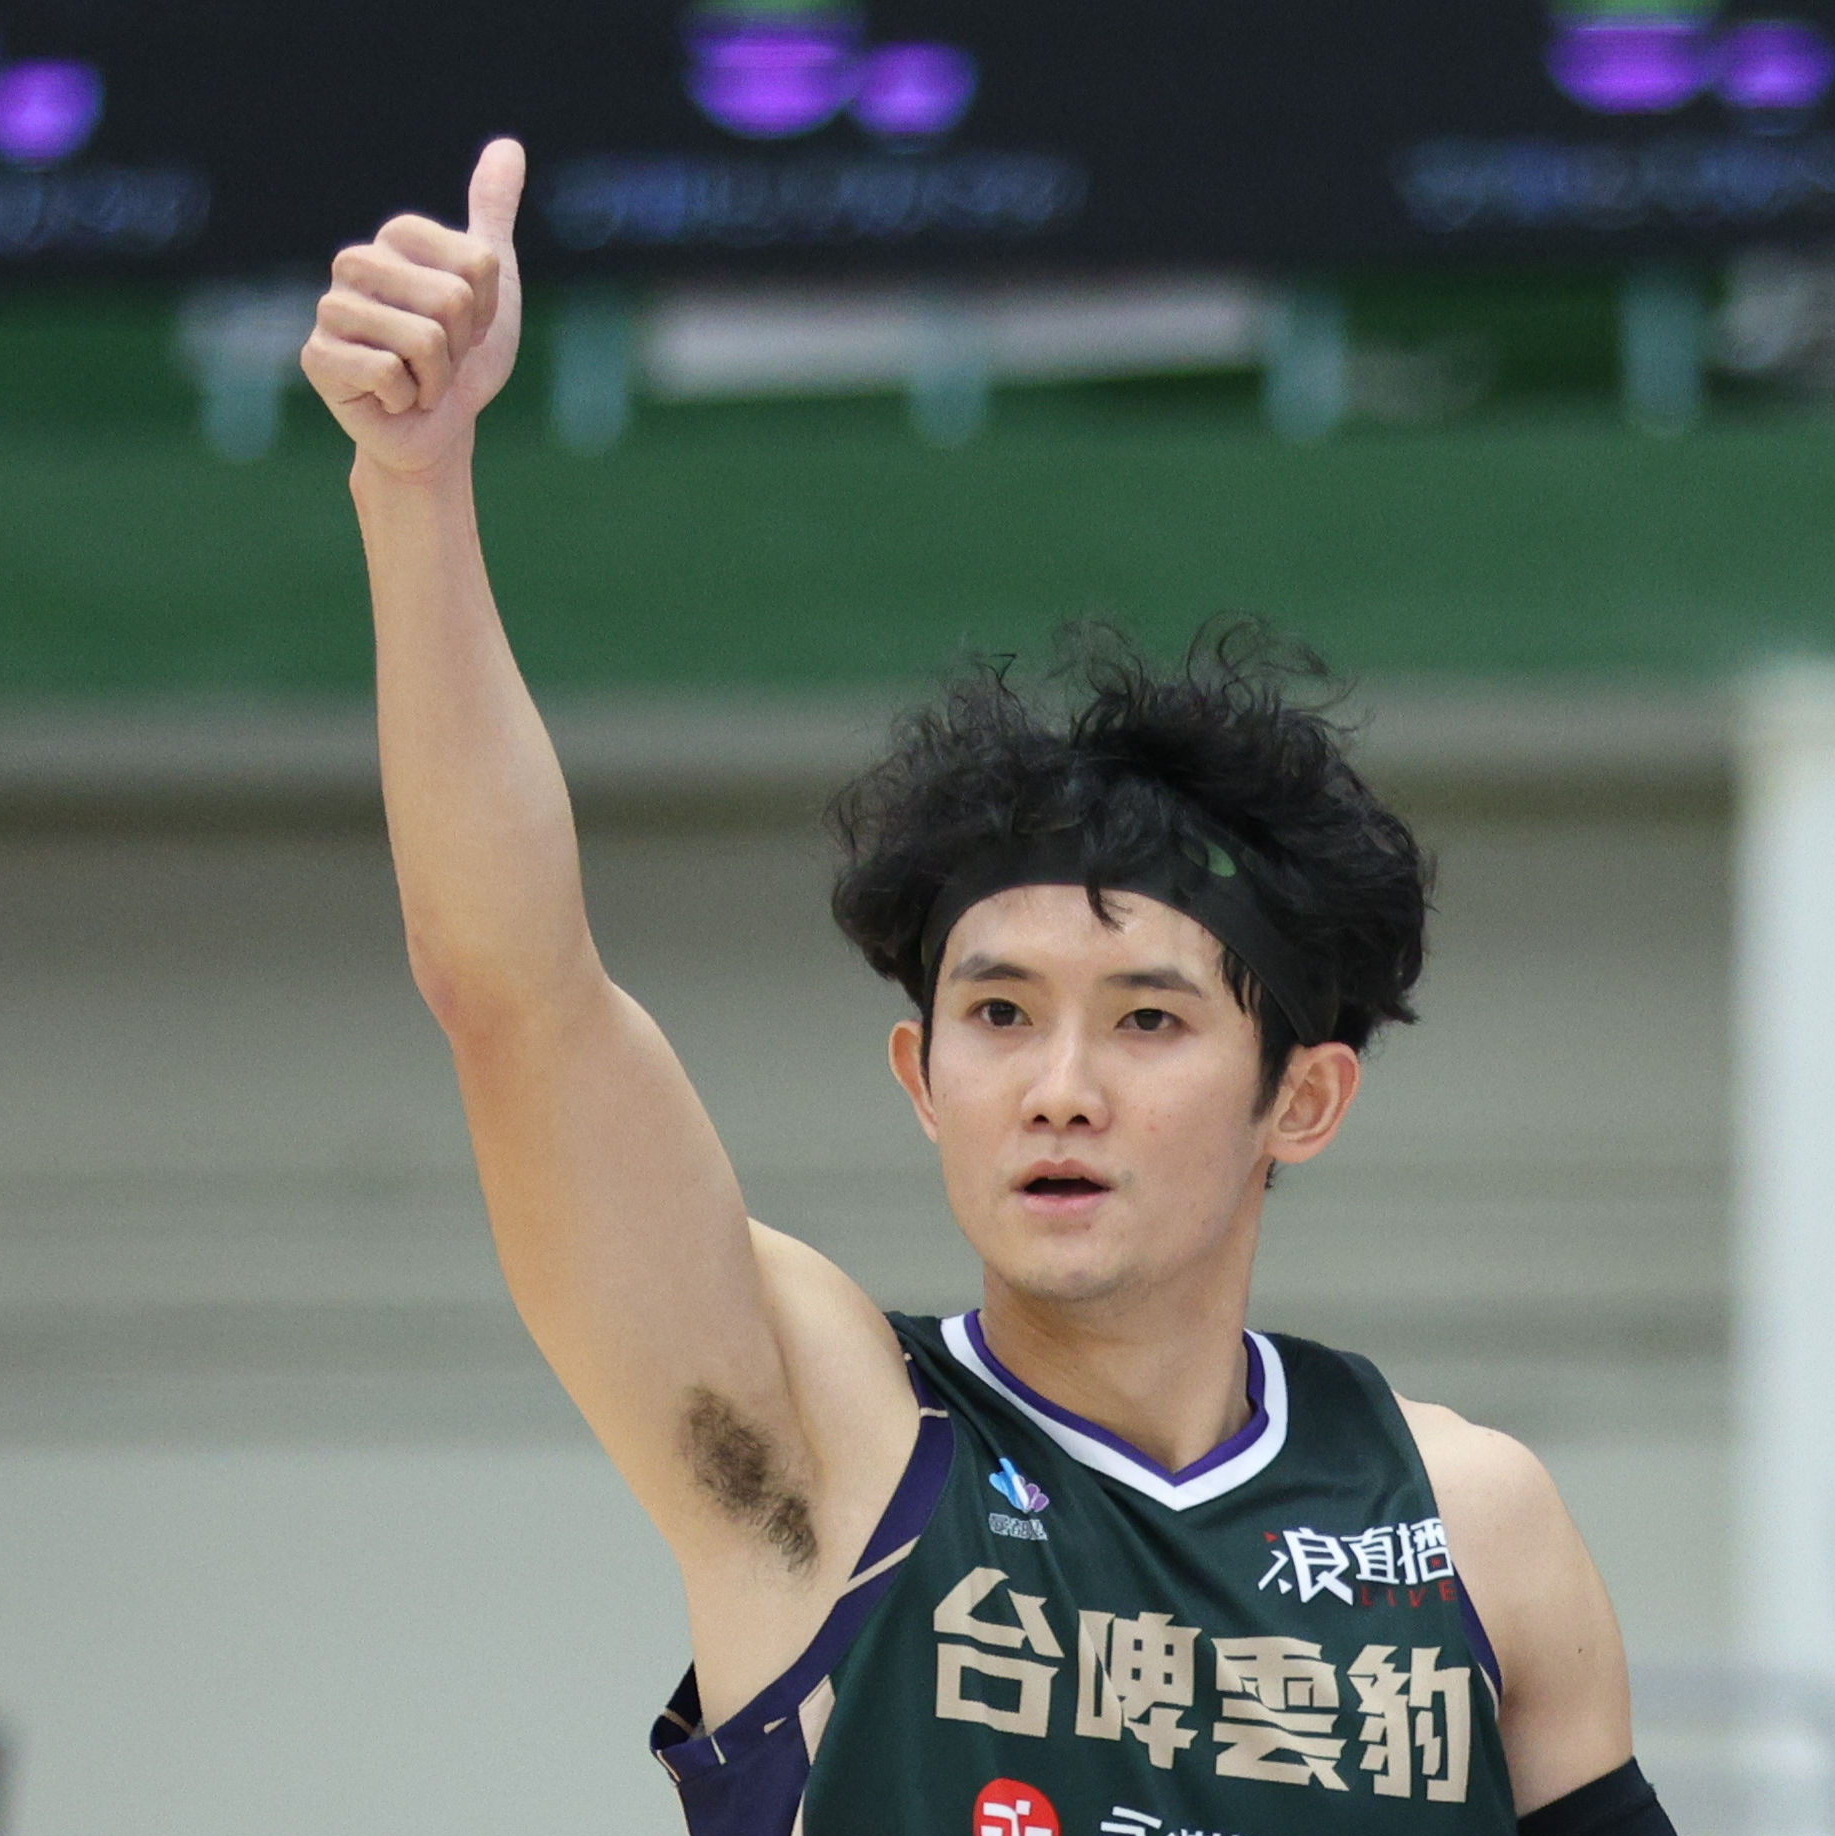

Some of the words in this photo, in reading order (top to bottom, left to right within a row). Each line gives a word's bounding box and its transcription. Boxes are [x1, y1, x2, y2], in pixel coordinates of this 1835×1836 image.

[1360, 1579, 1457, 1608] LIVE
[933, 1566, 1471, 1804] 台啤雲豹
